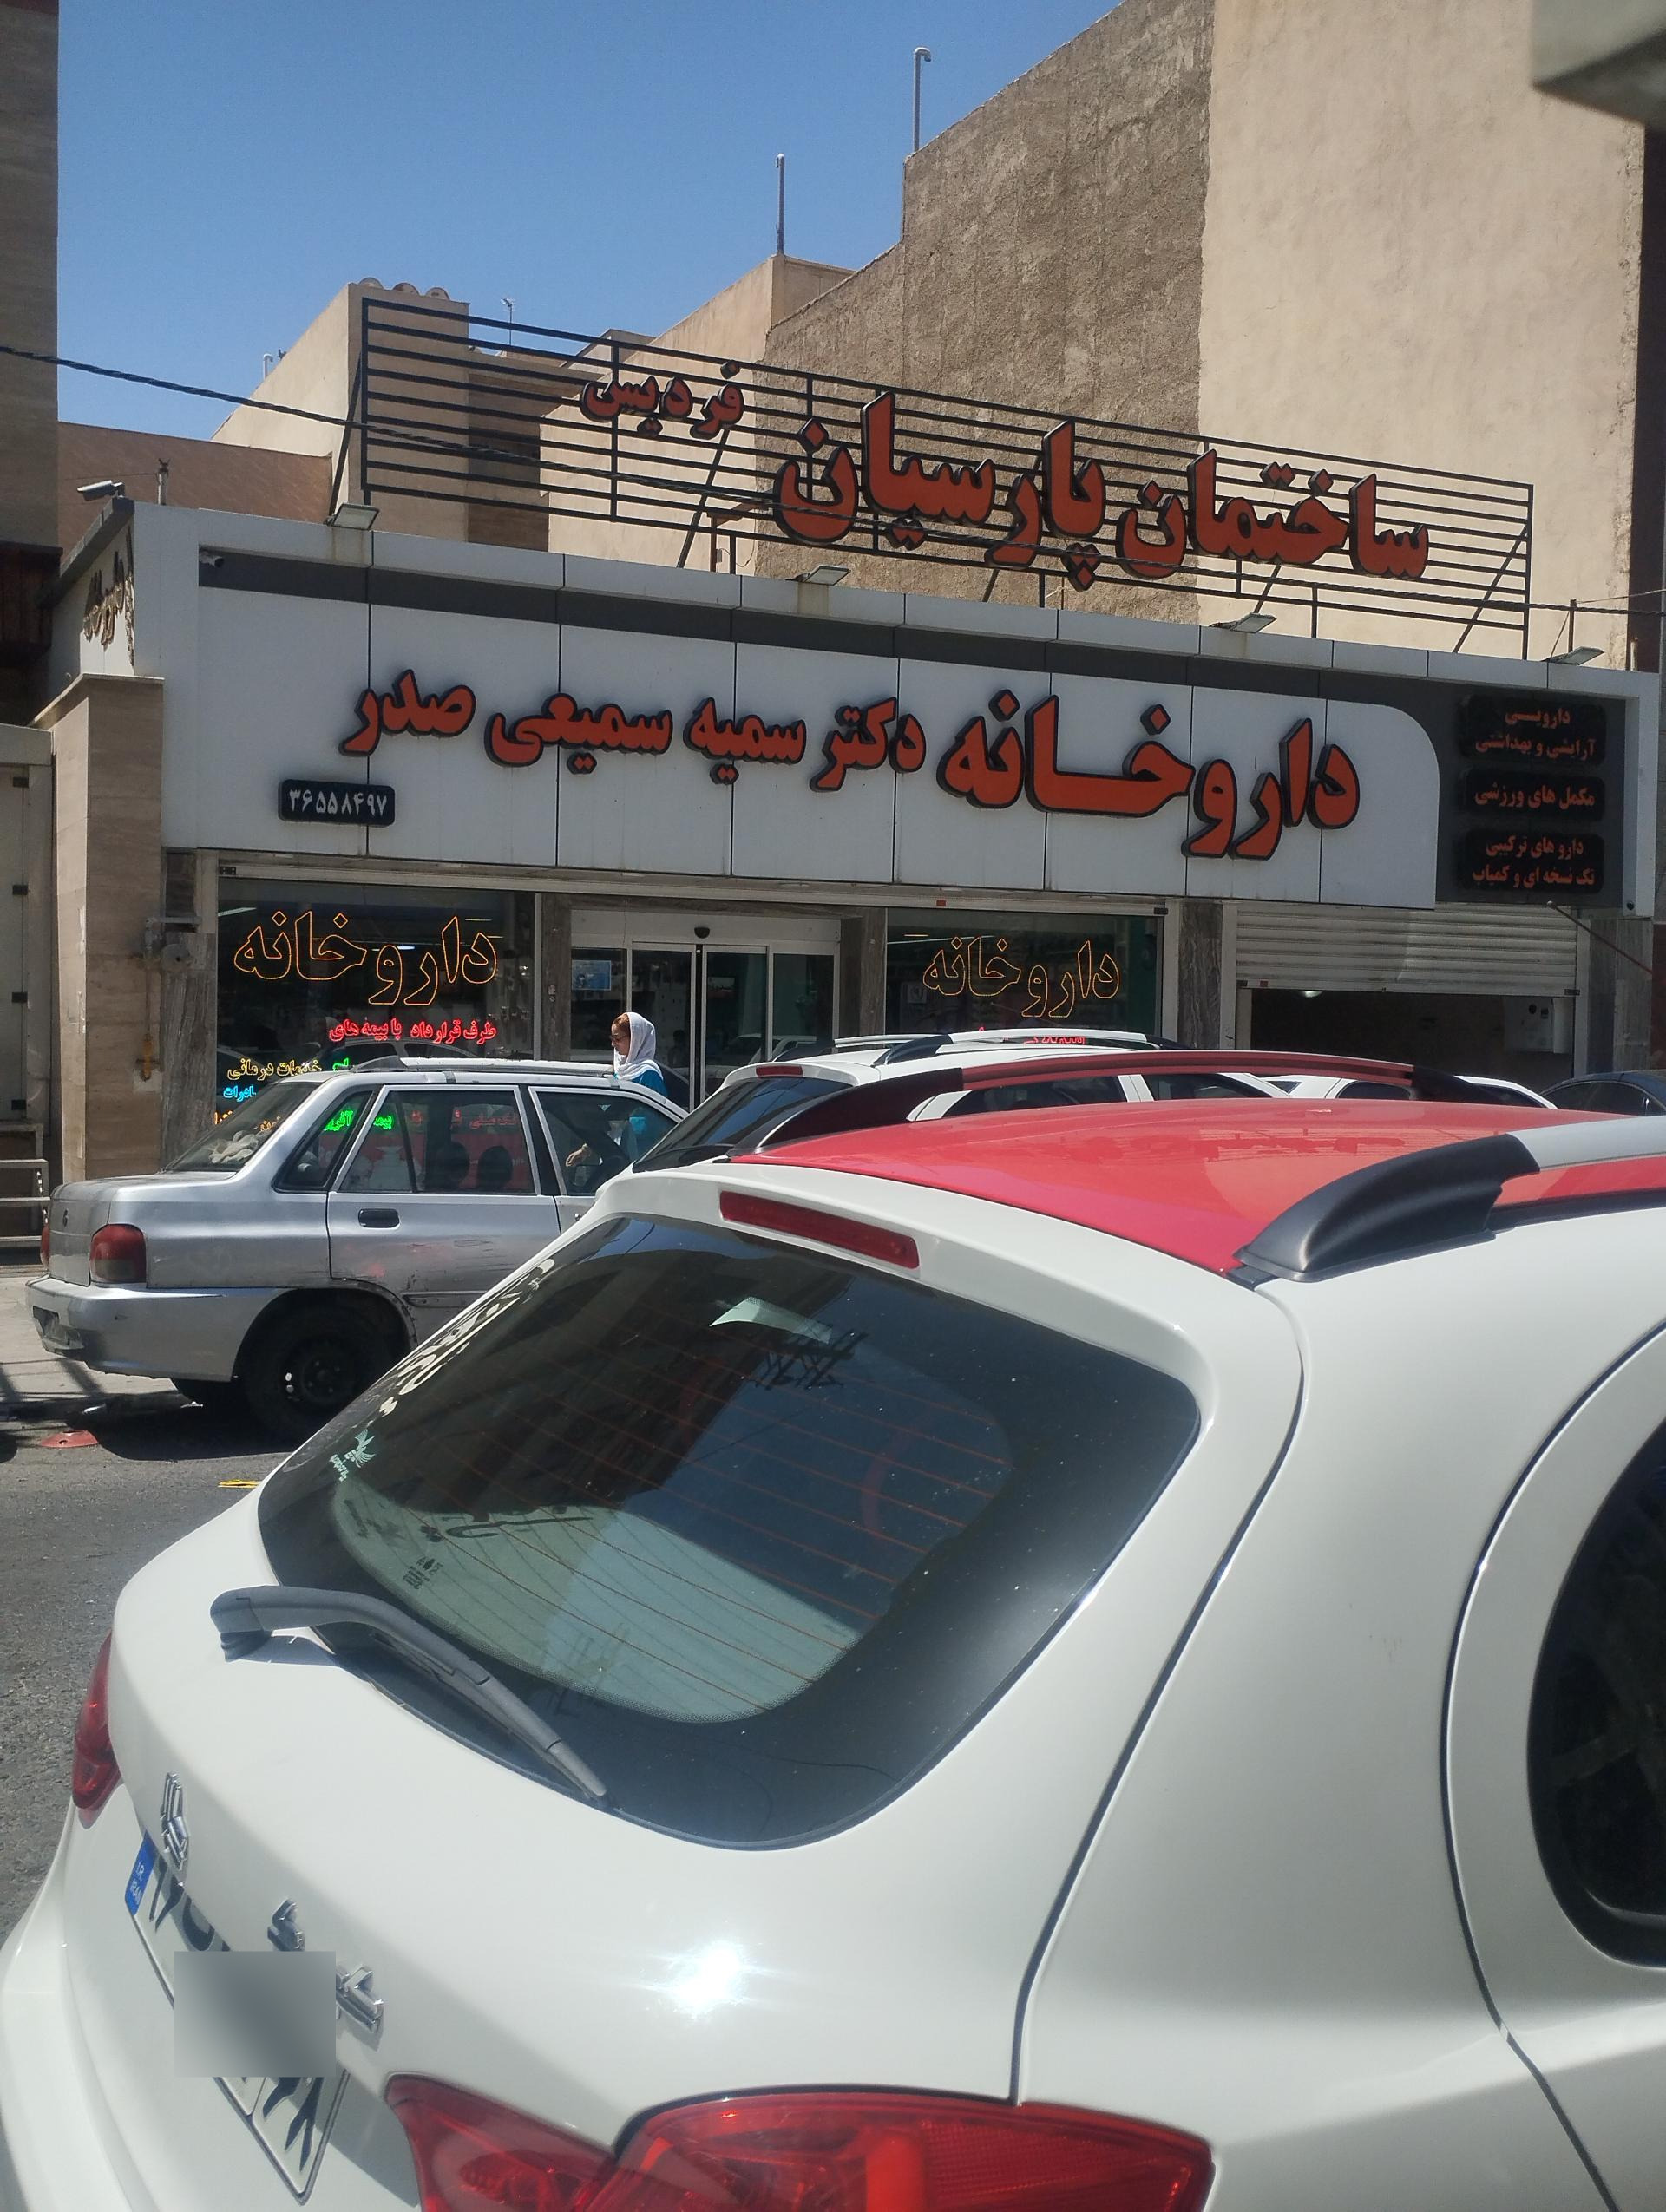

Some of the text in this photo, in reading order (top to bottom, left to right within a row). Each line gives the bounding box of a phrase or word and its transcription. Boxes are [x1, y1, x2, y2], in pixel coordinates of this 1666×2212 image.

[580, 360, 1429, 592] ساختمان پارسیان فردیس
[1475, 733, 1532, 756] بهداشتی
[1535, 742, 1544, 757] و
[339, 670, 1360, 861] داروخانه دکتر سمیه سمیعی صدر
[289, 789, 387, 817] ۳۶۵۵۸۴۹۷
[1475, 782, 1596, 809] مکمل های ورزشی
[1486, 834, 1527, 858] ترکیبی
[1530, 836, 1555, 858] های
[1473, 864, 1595, 888] تک نسخه ای و کمیاب
[234, 910, 497, 1005] داروخانه
[922, 936, 1119, 1018] داروخانه
[329, 1018, 359, 1042] های
[361, 1022, 389, 1041] بیمه
[390, 1018, 403, 1041] با
[463, 1019, 496, 1044] طرف
[227, 1057, 274, 1081] درمانی
[223, 1084, 257, 1103] ادرات
